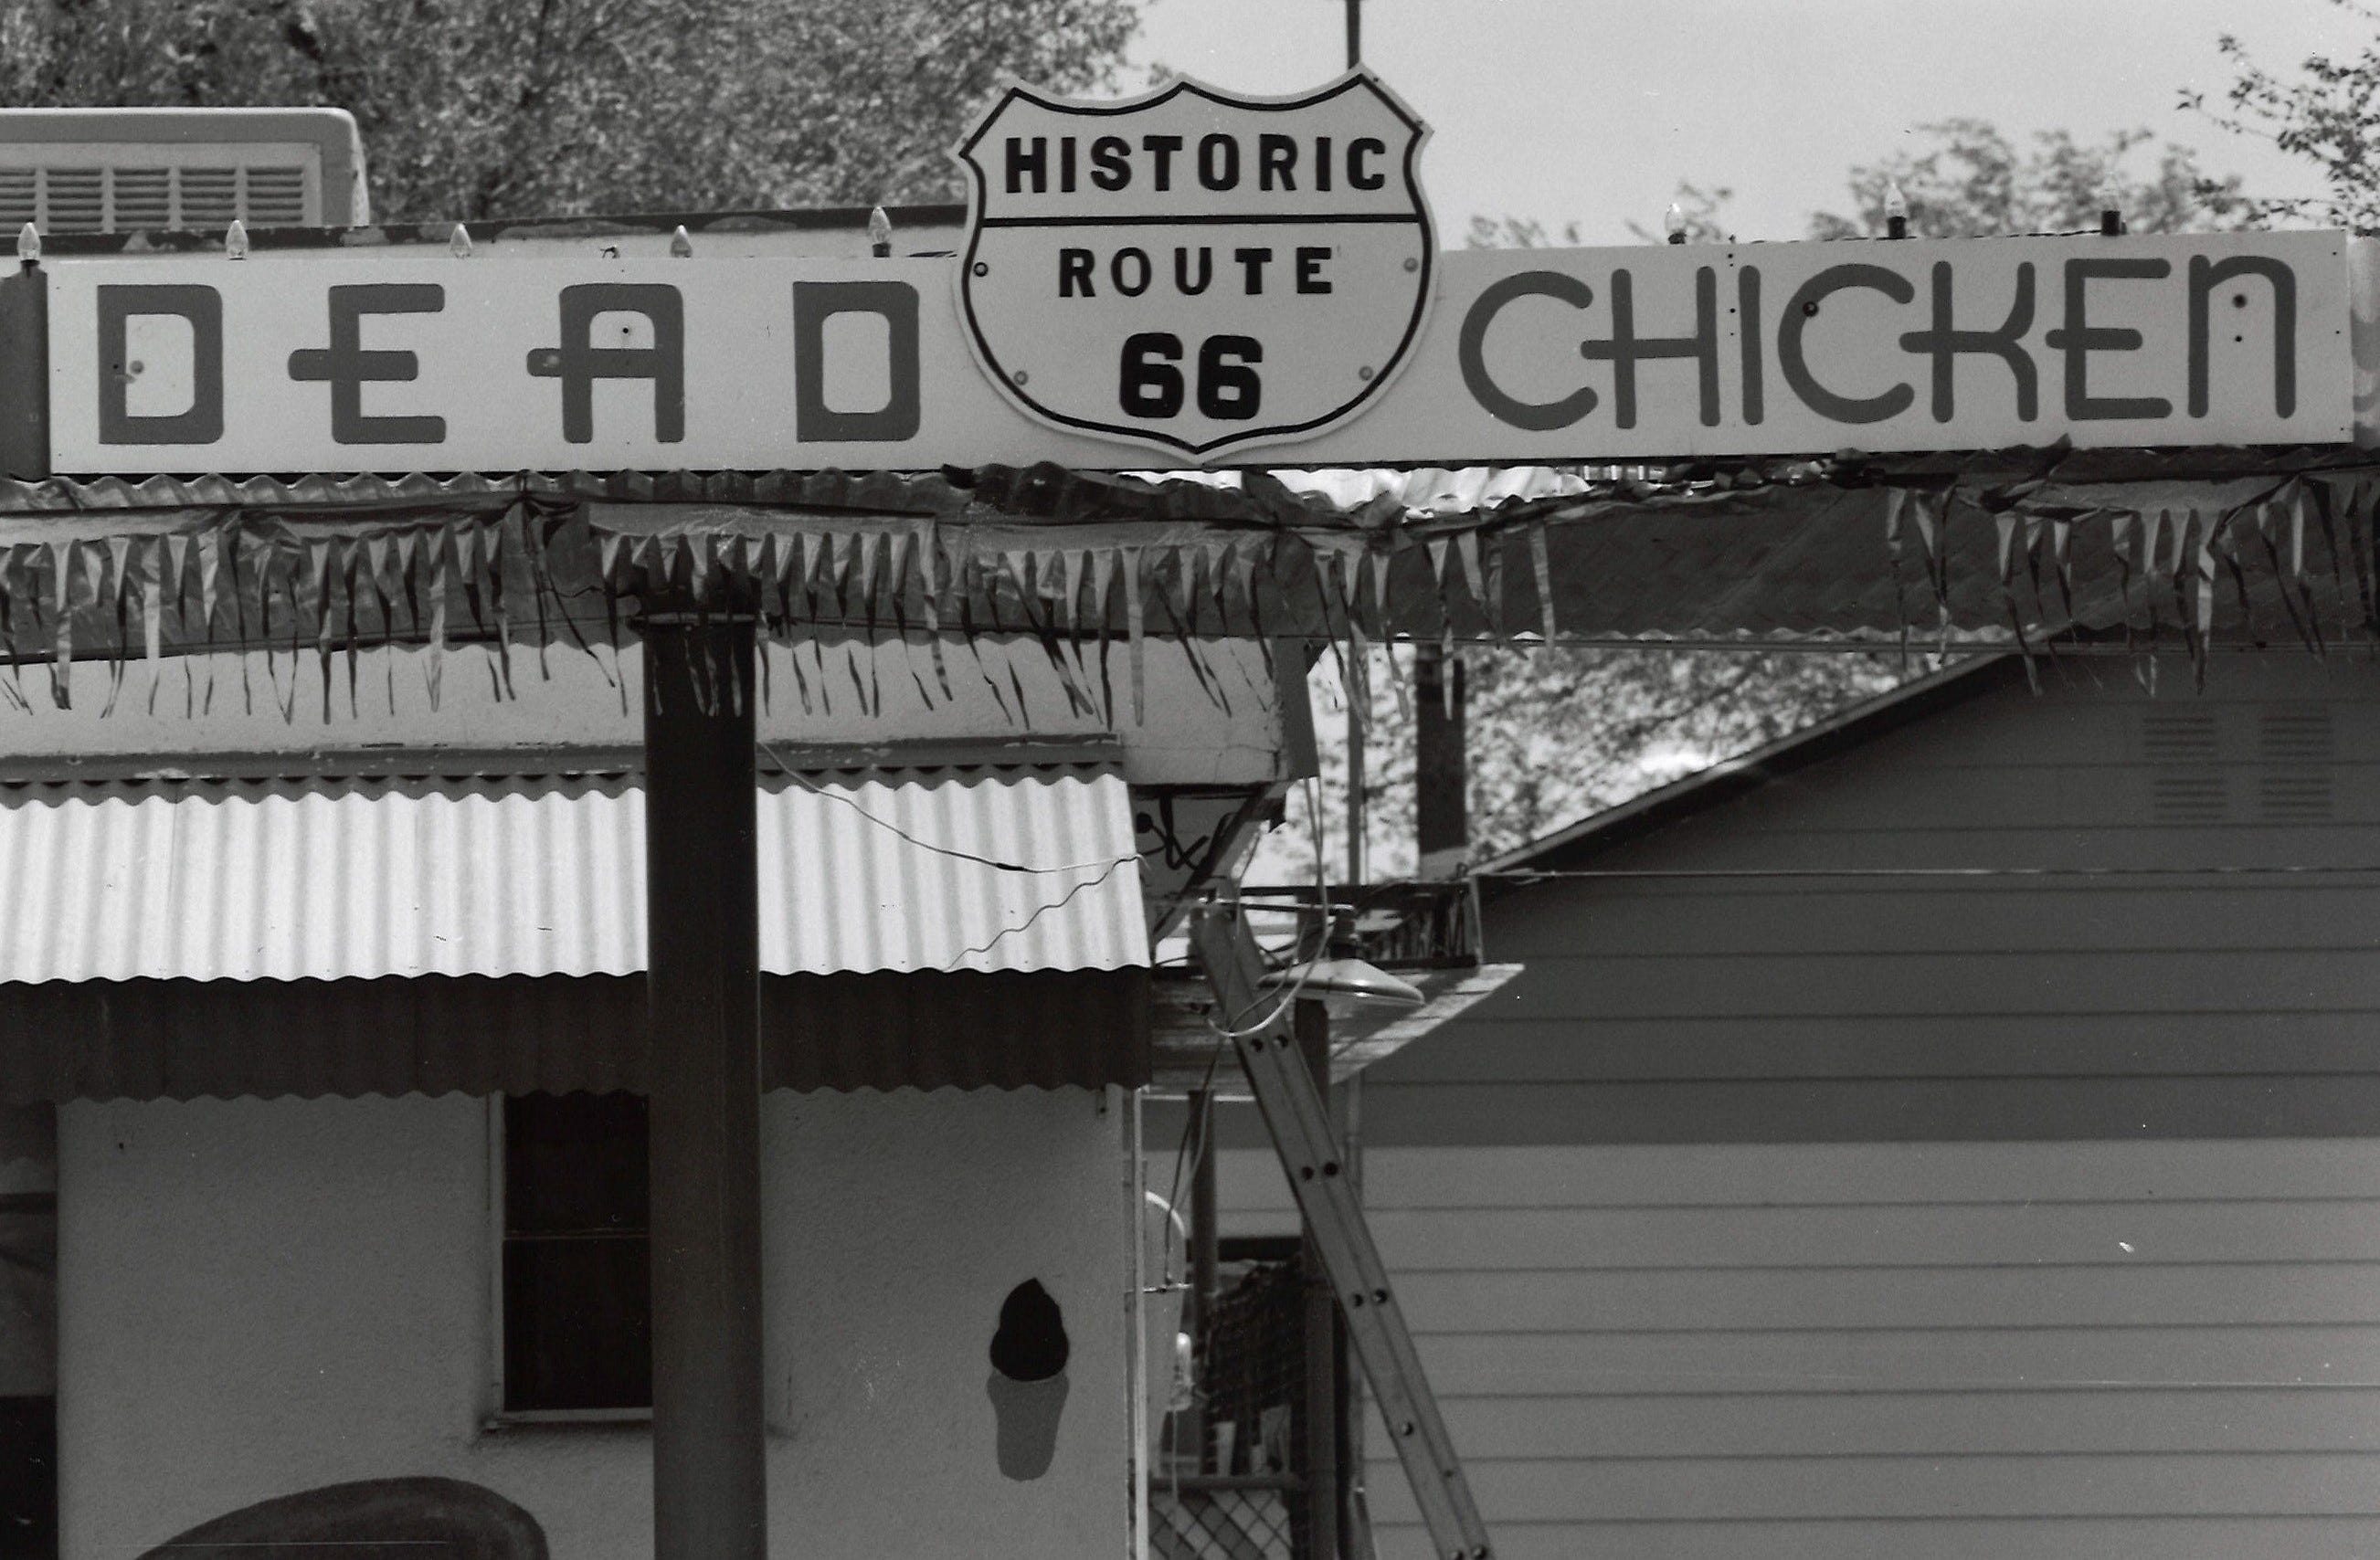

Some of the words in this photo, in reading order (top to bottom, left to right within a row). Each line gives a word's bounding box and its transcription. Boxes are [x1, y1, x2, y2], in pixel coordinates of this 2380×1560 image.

[1005, 133, 1387, 194] HISTORIC
[1059, 246, 1333, 298] ROUTE
[97, 280, 922, 446] DEAD
[1459, 253, 2297, 431] CHICKEN
[1119, 332, 1264, 420] 66
